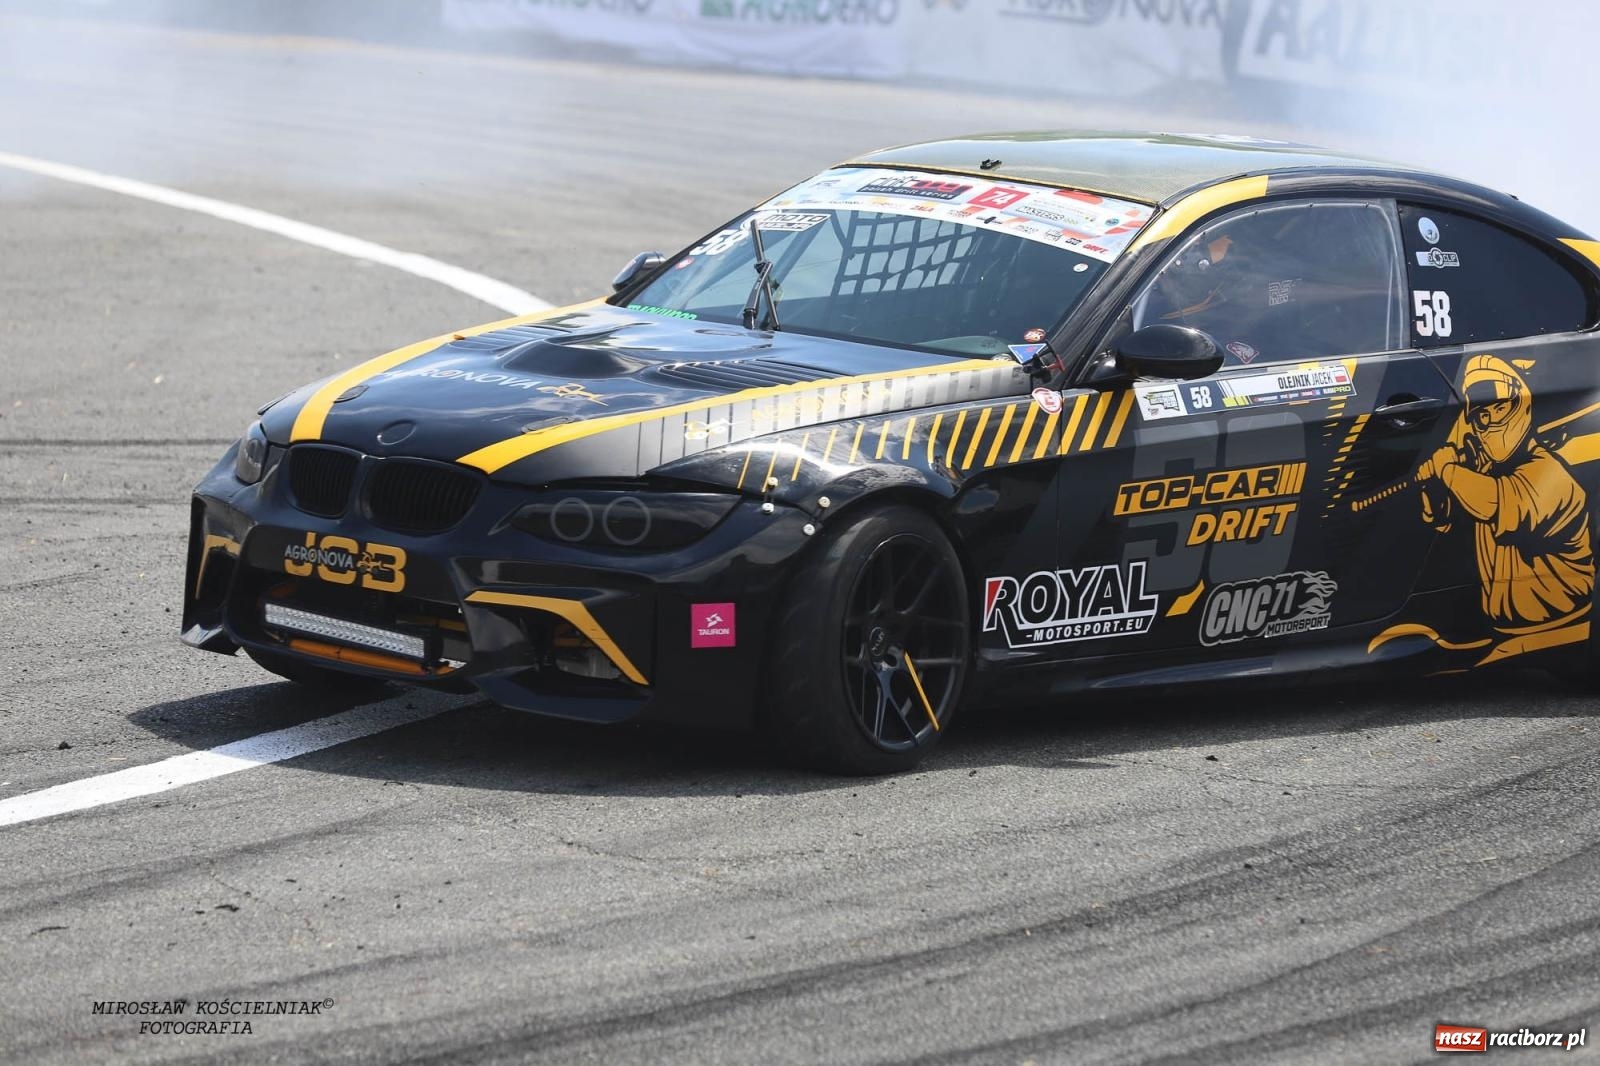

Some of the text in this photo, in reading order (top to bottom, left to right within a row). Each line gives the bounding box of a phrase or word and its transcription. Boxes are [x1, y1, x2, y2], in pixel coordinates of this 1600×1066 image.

[1413, 290, 1452, 337] 58
[1191, 386, 1213, 409] 58
[1278, 371, 1333, 390] OLEJNIK JACEK
[1114, 464, 1284, 515] TOP-CAR
[1186, 503, 1297, 546] DRIFT
[284, 544, 354, 569] AGRONOVA
[983, 561, 1158, 632] ROYAL
[1266, 614, 1331, 638] MOTORSPORT
